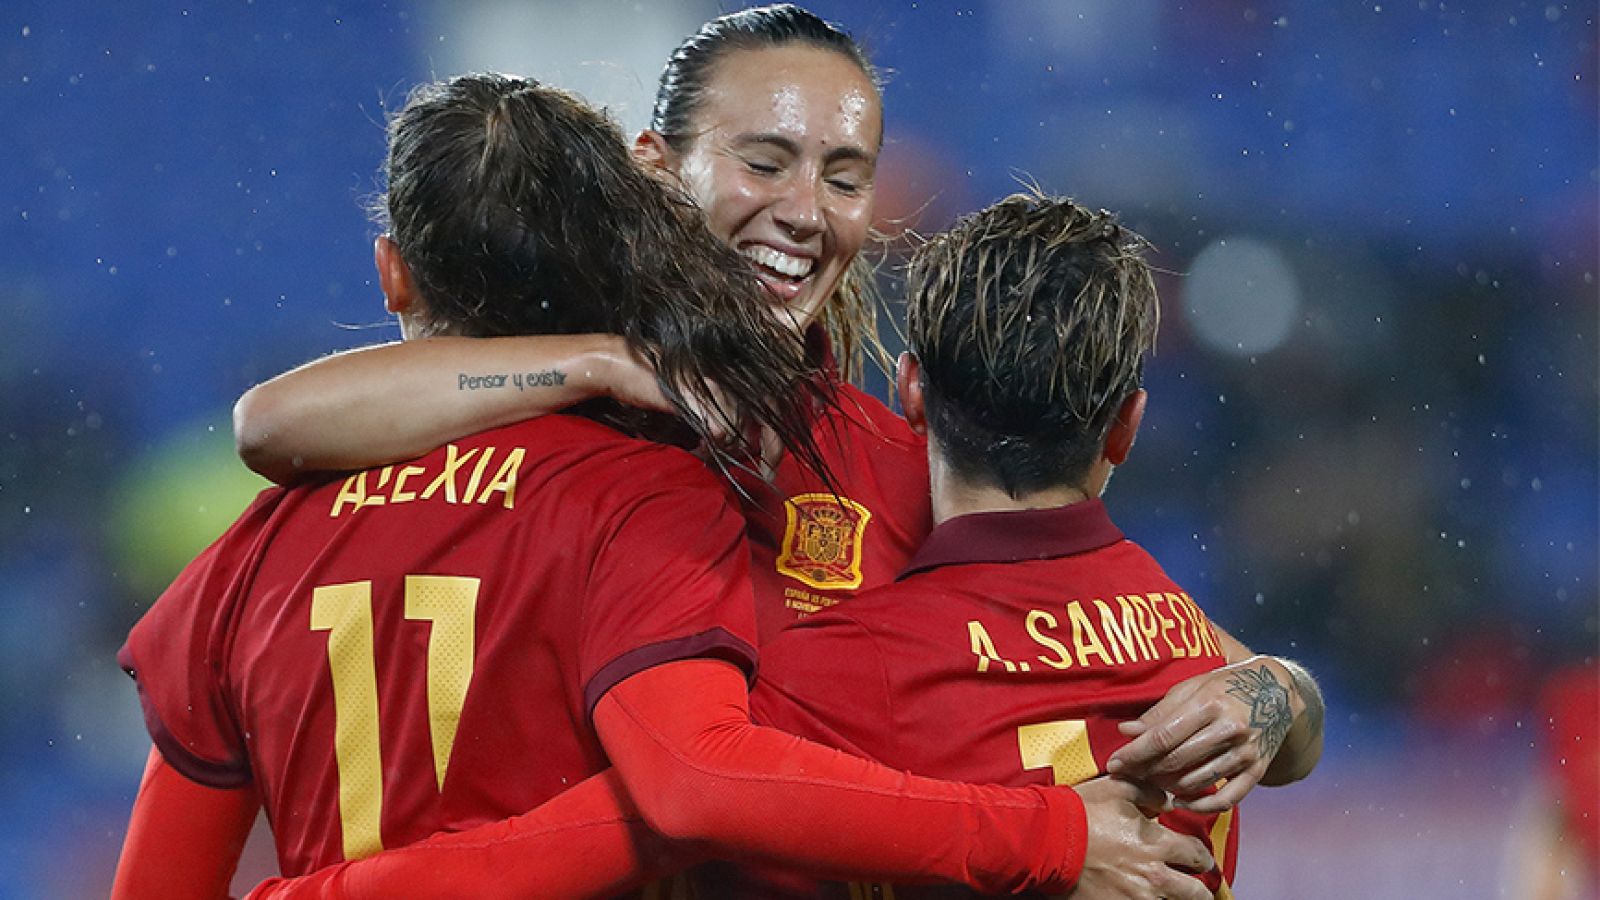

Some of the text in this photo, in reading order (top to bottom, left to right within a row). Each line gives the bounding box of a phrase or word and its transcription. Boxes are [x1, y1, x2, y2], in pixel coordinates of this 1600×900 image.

[457, 368, 568, 392] Pensar y existir
[329, 444, 527, 518] ALEXIA
[310, 574, 481, 861] 11
